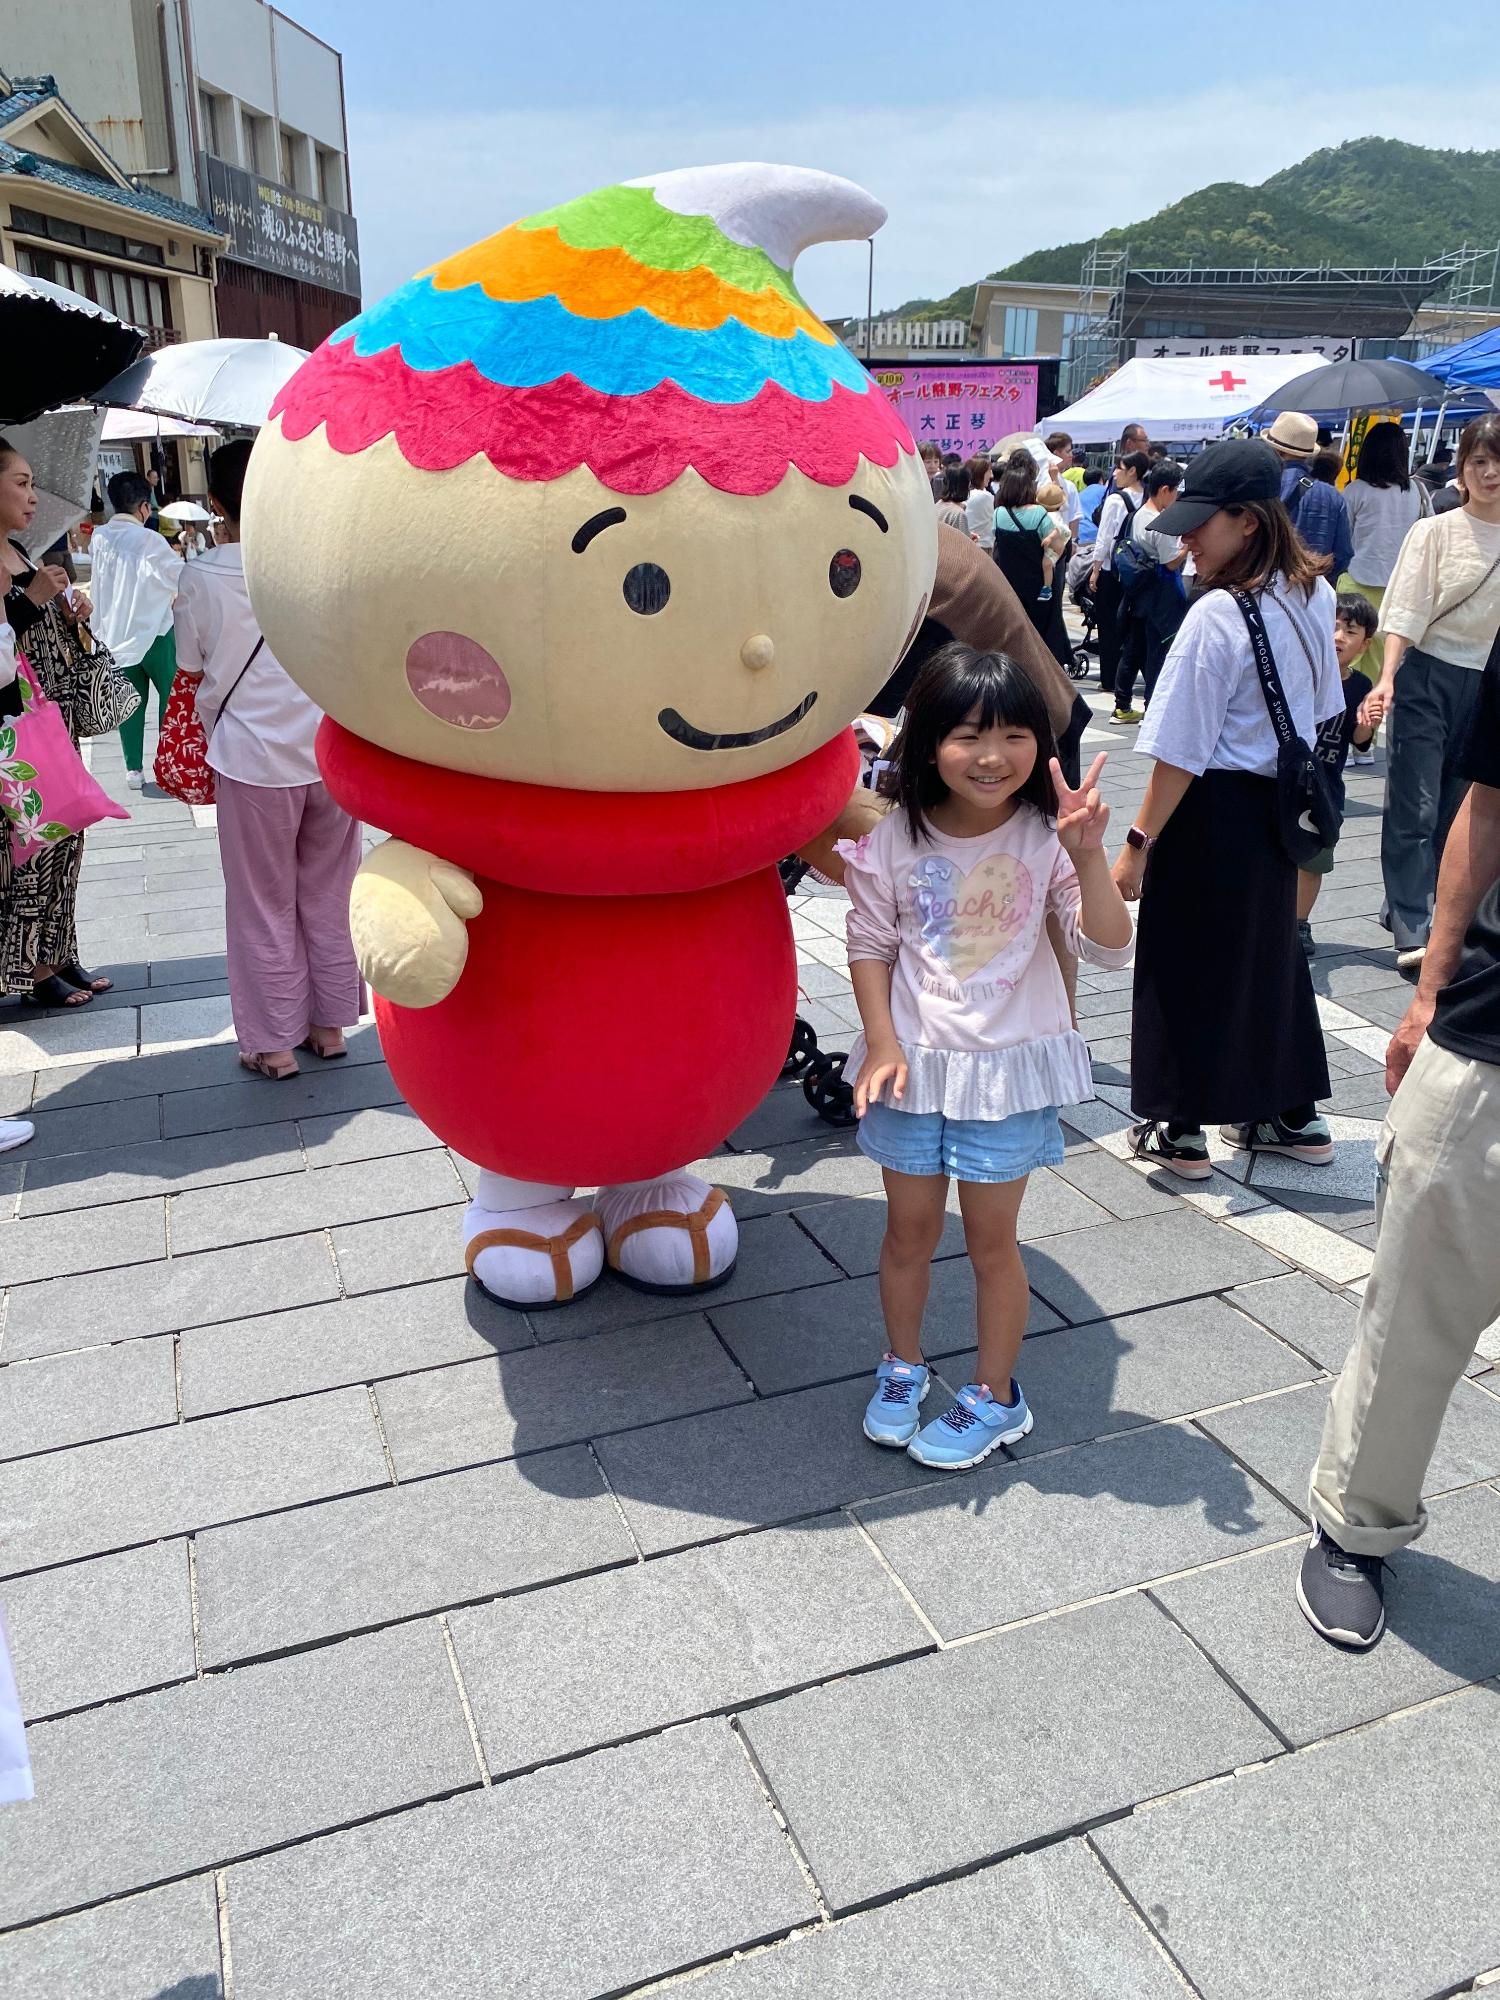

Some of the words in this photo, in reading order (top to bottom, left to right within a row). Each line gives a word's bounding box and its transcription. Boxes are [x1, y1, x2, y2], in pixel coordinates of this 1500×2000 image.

[887, 382, 1022, 404] オール熊野フェスタ
[920, 413, 986, 430] 大正琴
[1255, 633, 1272, 676] SWOOSH
[1272, 700, 1292, 742] SWOOSH
[912, 889, 1023, 932] Peachy
